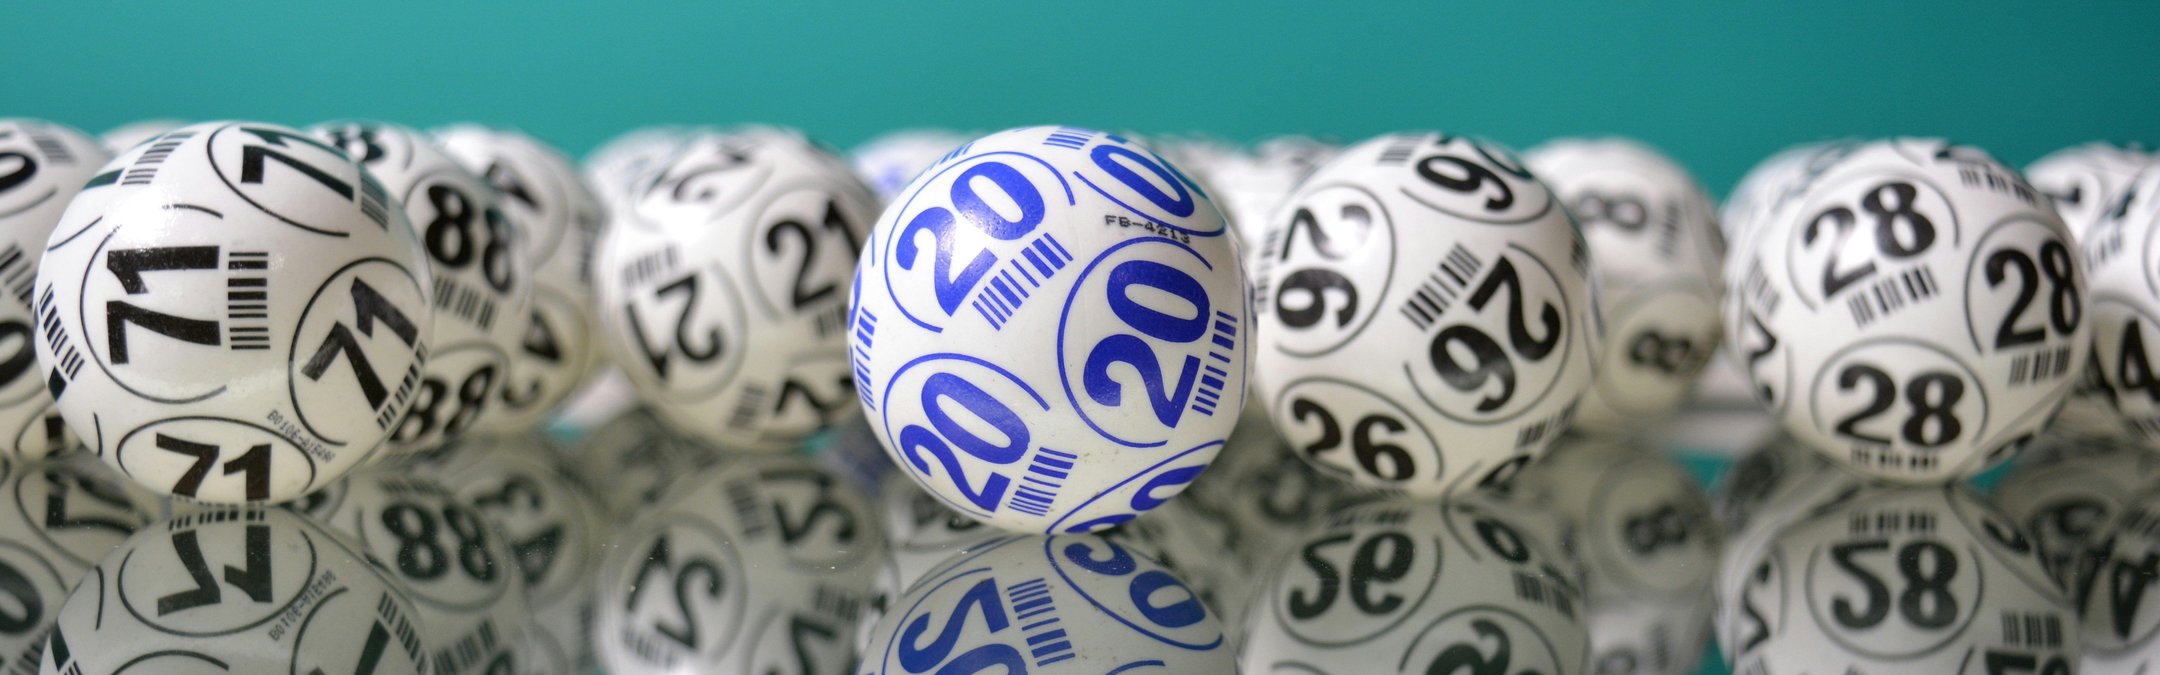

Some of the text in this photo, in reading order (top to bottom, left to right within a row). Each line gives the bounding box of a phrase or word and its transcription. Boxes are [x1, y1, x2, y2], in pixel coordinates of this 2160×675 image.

[425, 183, 515, 295] 88
[765, 199, 860, 309] 21
[896, 161, 1046, 317] 20
[1105, 214, 1191, 244] FB-4213
[1275, 204, 1374, 331] 26
[1804, 181, 1936, 297] 28
[106, 245, 222, 365] 71
[301, 276, 419, 413] 71
[626, 274, 724, 382] 21
[1083, 260, 1211, 429] 20
[1428, 255, 1562, 414] 26
[1984, 239, 2082, 350] 28
[899, 372, 1031, 513] 20
[1291, 396, 1417, 481] 26
[1835, 363, 1965, 448] 28
[156, 432, 272, 500] 71
